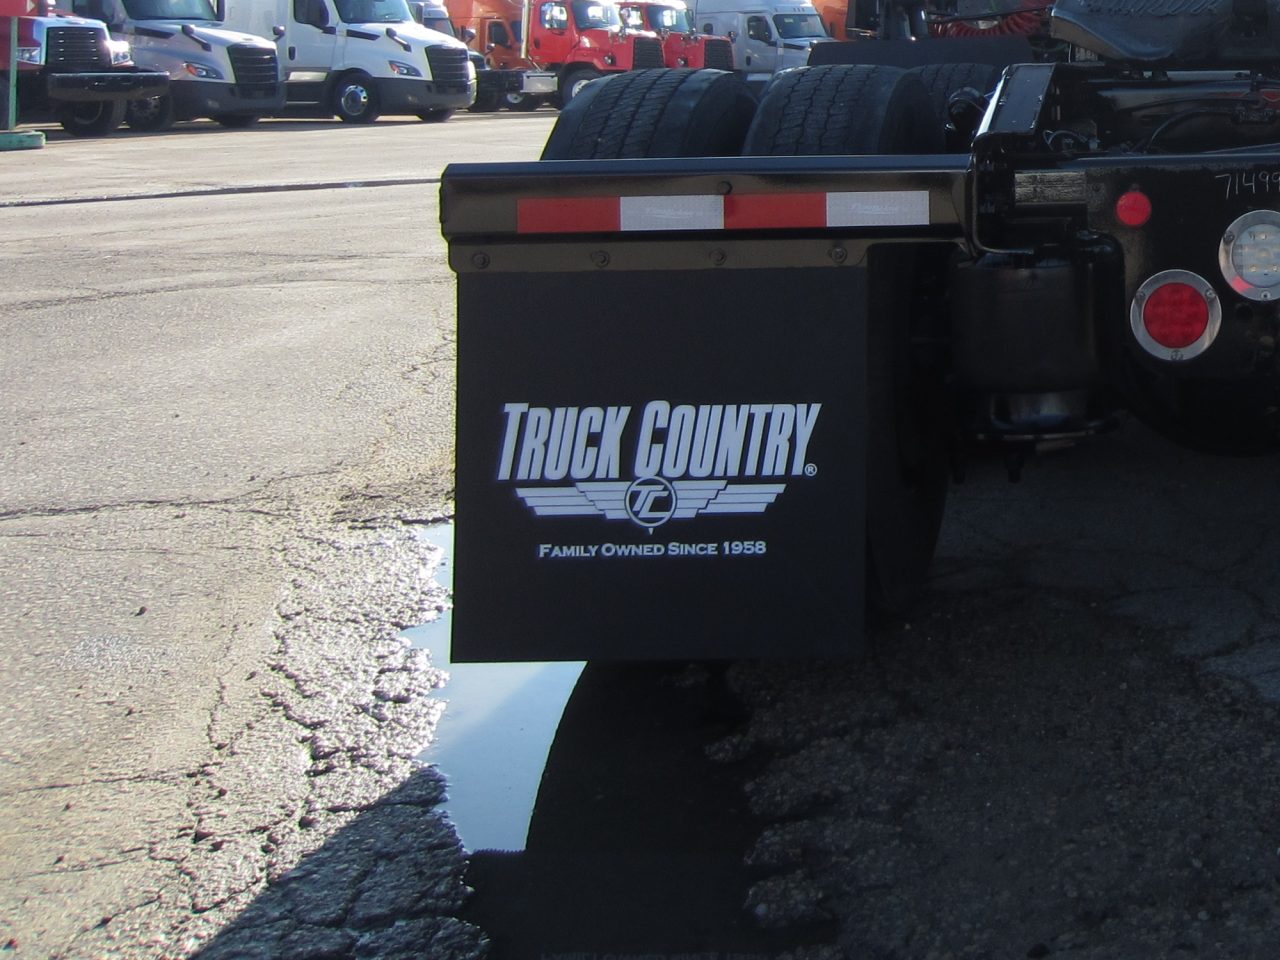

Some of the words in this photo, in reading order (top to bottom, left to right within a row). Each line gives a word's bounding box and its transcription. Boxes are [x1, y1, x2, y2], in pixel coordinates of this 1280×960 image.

[497, 402, 632, 481] TRUCK
[633, 400, 823, 479] COUNTRY
[539, 543, 598, 558] FAMILY
[600, 542, 665, 557] OWNED
[667, 541, 718, 555] SINCE
[722, 540, 767, 555] 1958
